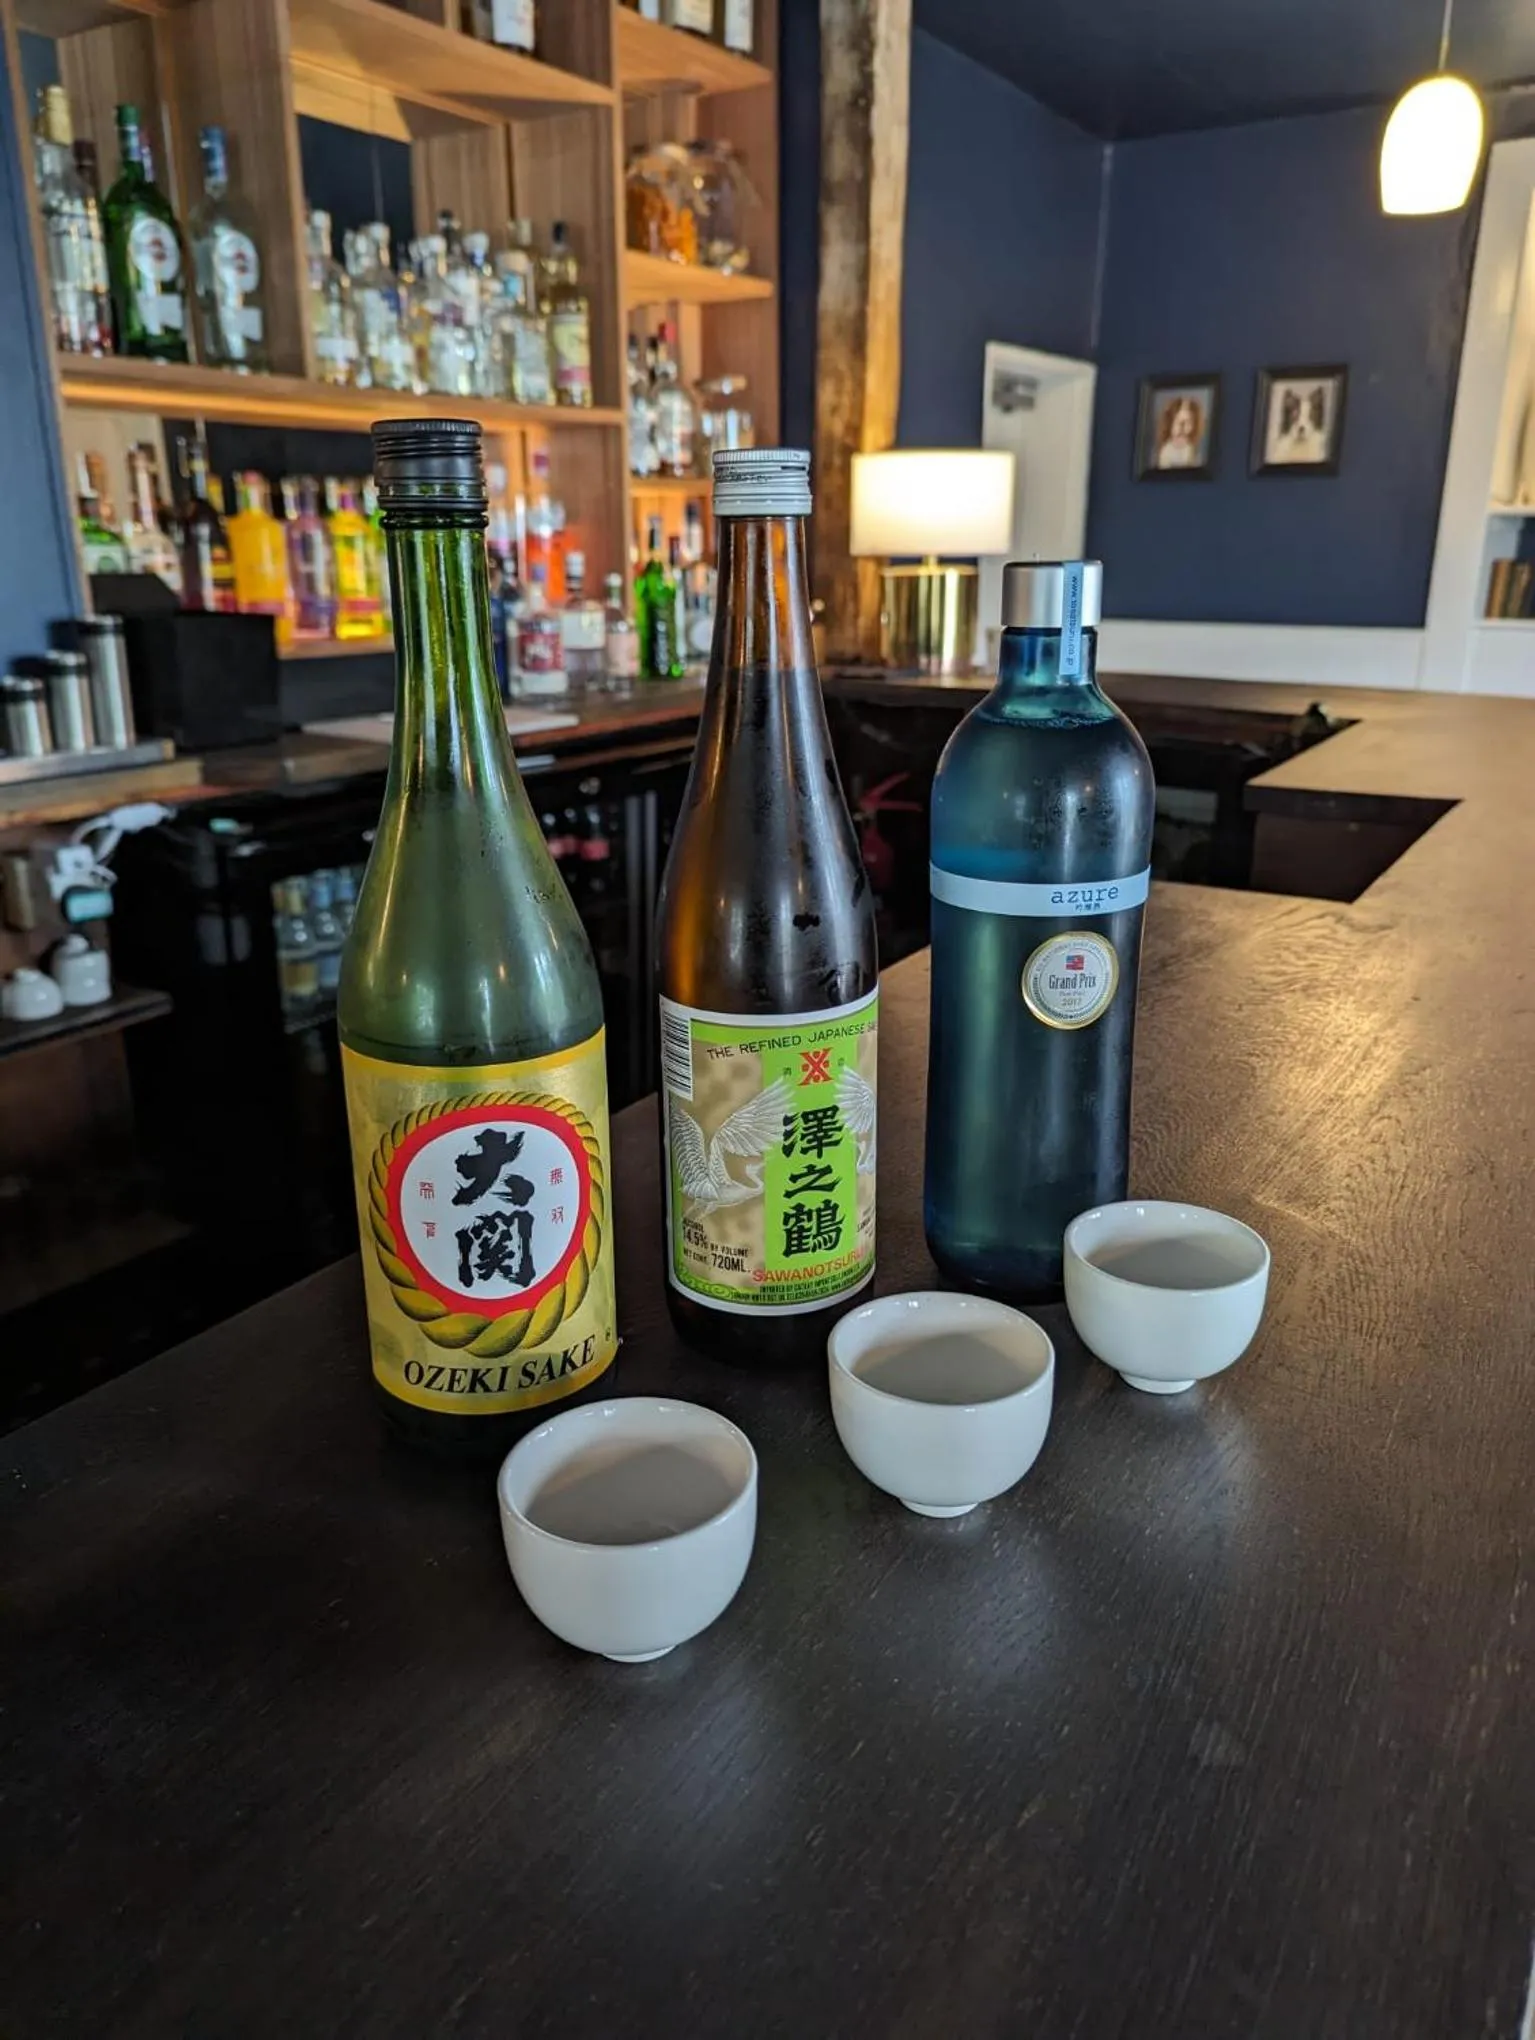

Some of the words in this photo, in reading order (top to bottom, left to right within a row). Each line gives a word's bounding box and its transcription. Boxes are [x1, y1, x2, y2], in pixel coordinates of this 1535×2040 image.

[1051, 886, 1119, 904] azure
[1049, 974, 1078, 989] Grand
[1079, 973, 1097, 989] Prix
[707, 1046, 735, 1060] THE
[739, 1035, 802, 1055] REFINED
[808, 1022, 865, 1043] JAPANESE
[752, 1246, 866, 1284] SAWANOTSURU
[403, 1360, 512, 1393] OZEKI
[517, 1335, 596, 1389] SAKE
